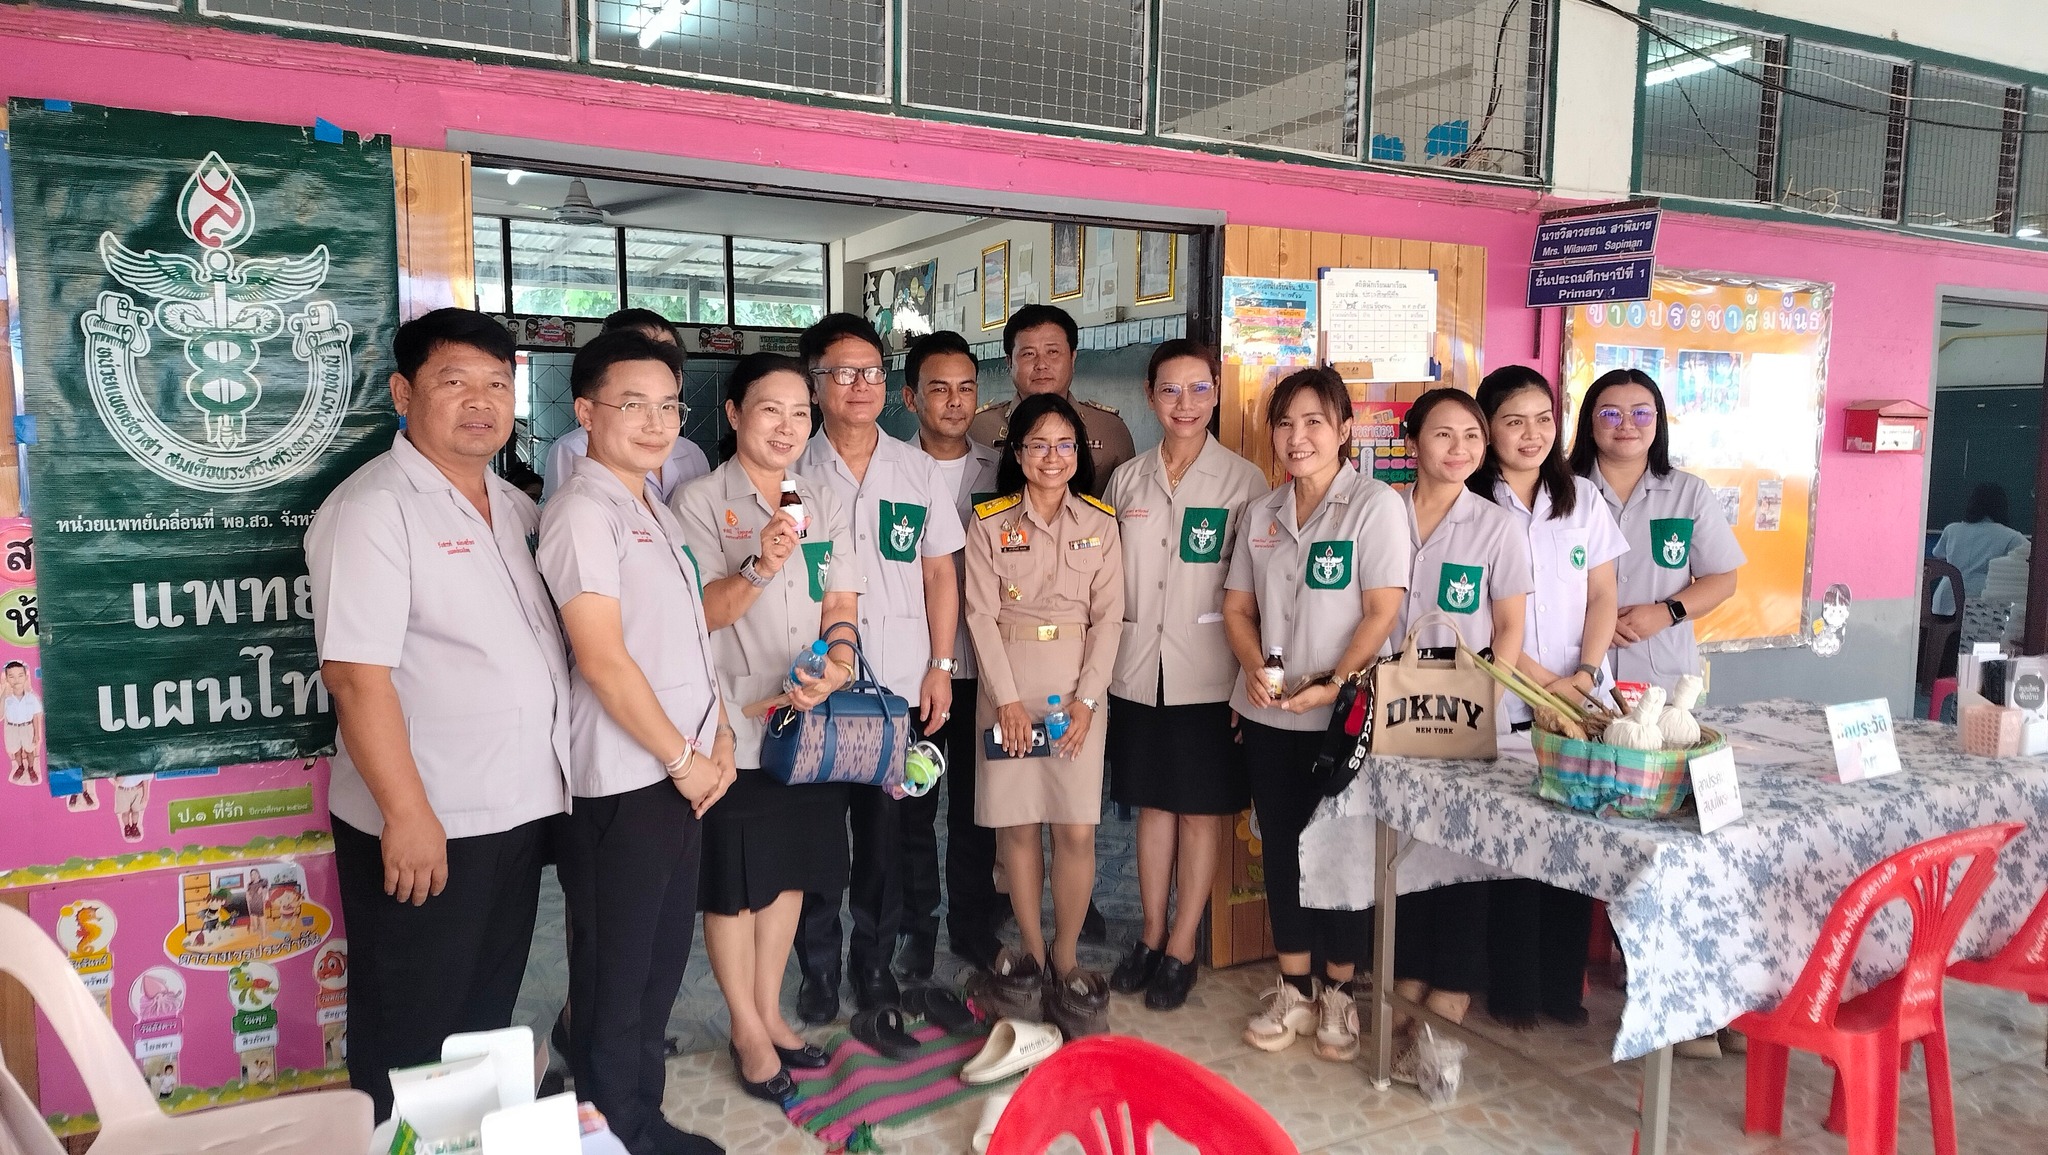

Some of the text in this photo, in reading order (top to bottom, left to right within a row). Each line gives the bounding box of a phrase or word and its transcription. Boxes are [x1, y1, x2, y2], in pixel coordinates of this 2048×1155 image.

[1542, 238, 1643, 257] Mrs. Wilawan Sapiman
[1535, 262, 1645, 287] ชั้นประถมศึกษาปีที่ 1
[1558, 287, 1616, 300] Primary 1
[95, 346, 165, 458] หน่วยแพทย์อาสา
[56, 508, 215, 533] หน่วยแพทย์เคลื่อนที่
[221, 514, 273, 529] พอ.สว.
[1385, 694, 1484, 730] DKNY
[1415, 726, 1454, 735] NEW YORK
[177, 807, 207, 823] ป.๑
[213, 799, 244, 820] ที่รัก
[178, 930, 321, 965] ตารางเวรประจำวัน
